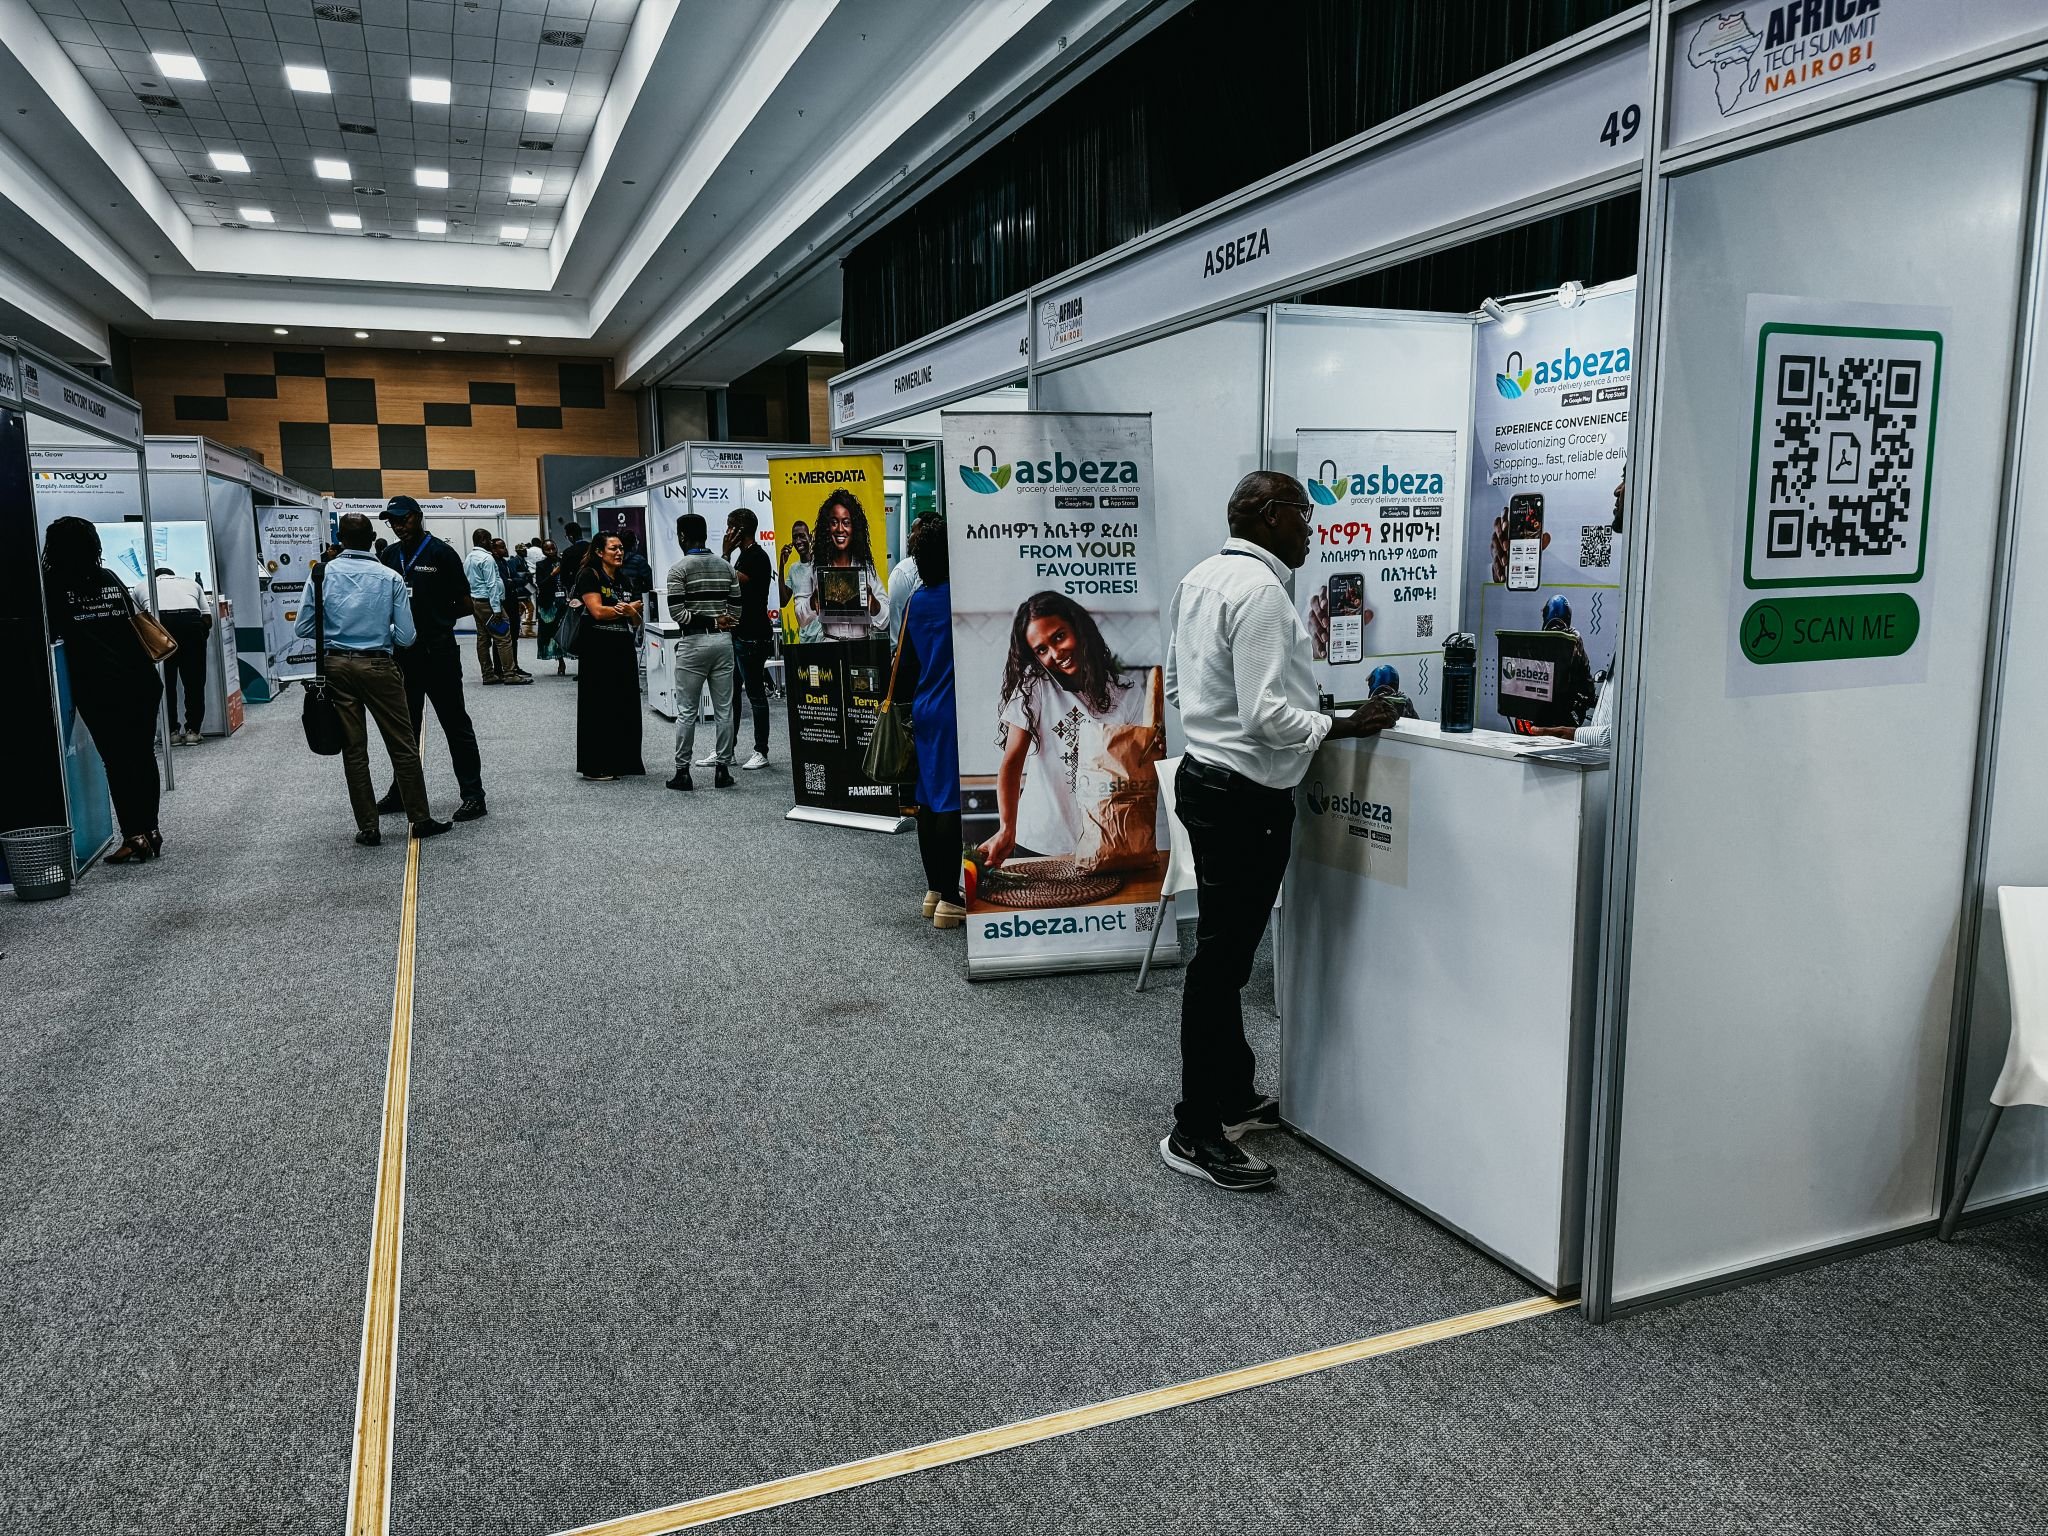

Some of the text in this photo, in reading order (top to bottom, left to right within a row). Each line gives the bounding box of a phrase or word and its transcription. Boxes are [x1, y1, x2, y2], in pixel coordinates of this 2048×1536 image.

[1763, 12, 1881, 73] TECH SUMMIT
[1764, 40, 1873, 95] NAIROBI
[1599, 103, 1641, 148] 49
[1203, 227, 1271, 279] ASBEZA
[1059, 296, 1083, 323] AFRICA
[1534, 347, 1631, 385] asbeza
[894, 365, 932, 395] FARMERLINE
[1534, 385, 1557, 396] grocery
[1558, 381, 1582, 391] delivery
[1583, 377, 1605, 387] service
[1612, 374, 1631, 382] more
[1495, 420, 1553, 437] EXPERIENCE
[1494, 432, 1607, 453] Revolutionizing Grocery
[719, 452, 744, 461] AFRICA
[1493, 447, 1628, 470] Shopping... fast, reliable deliv
[798, 469, 866, 485] MERGDATA
[892, 464, 904, 472] 47
[1015, 451, 1139, 484] asbeza
[1492, 468, 1597, 487] straight to your home!
[1016, 486, 1047, 495] grocery
[1049, 485, 1081, 494] delivery
[1082, 485, 1111, 493] service
[1111, 485, 1118, 493] &
[1350, 464, 1444, 495] asbeza
[1350, 497, 1374, 506] grocery
[1375, 496, 1400, 504] delivery
[1019, 541, 1136, 559] FROM YOUR
[1036, 562, 1137, 577] FAVOURITE
[1064, 580, 1138, 595] STORES!
[1792, 614, 1896, 645] SCAN ME
[1516, 666, 1549, 682] asbeza
[805, 693, 829, 705] Darli
[852, 696, 879, 707] Terra
[848, 785, 893, 796] FARMERLINE
[1331, 791, 1392, 824] asbeza
[983, 910, 1127, 940] asbeza.net
